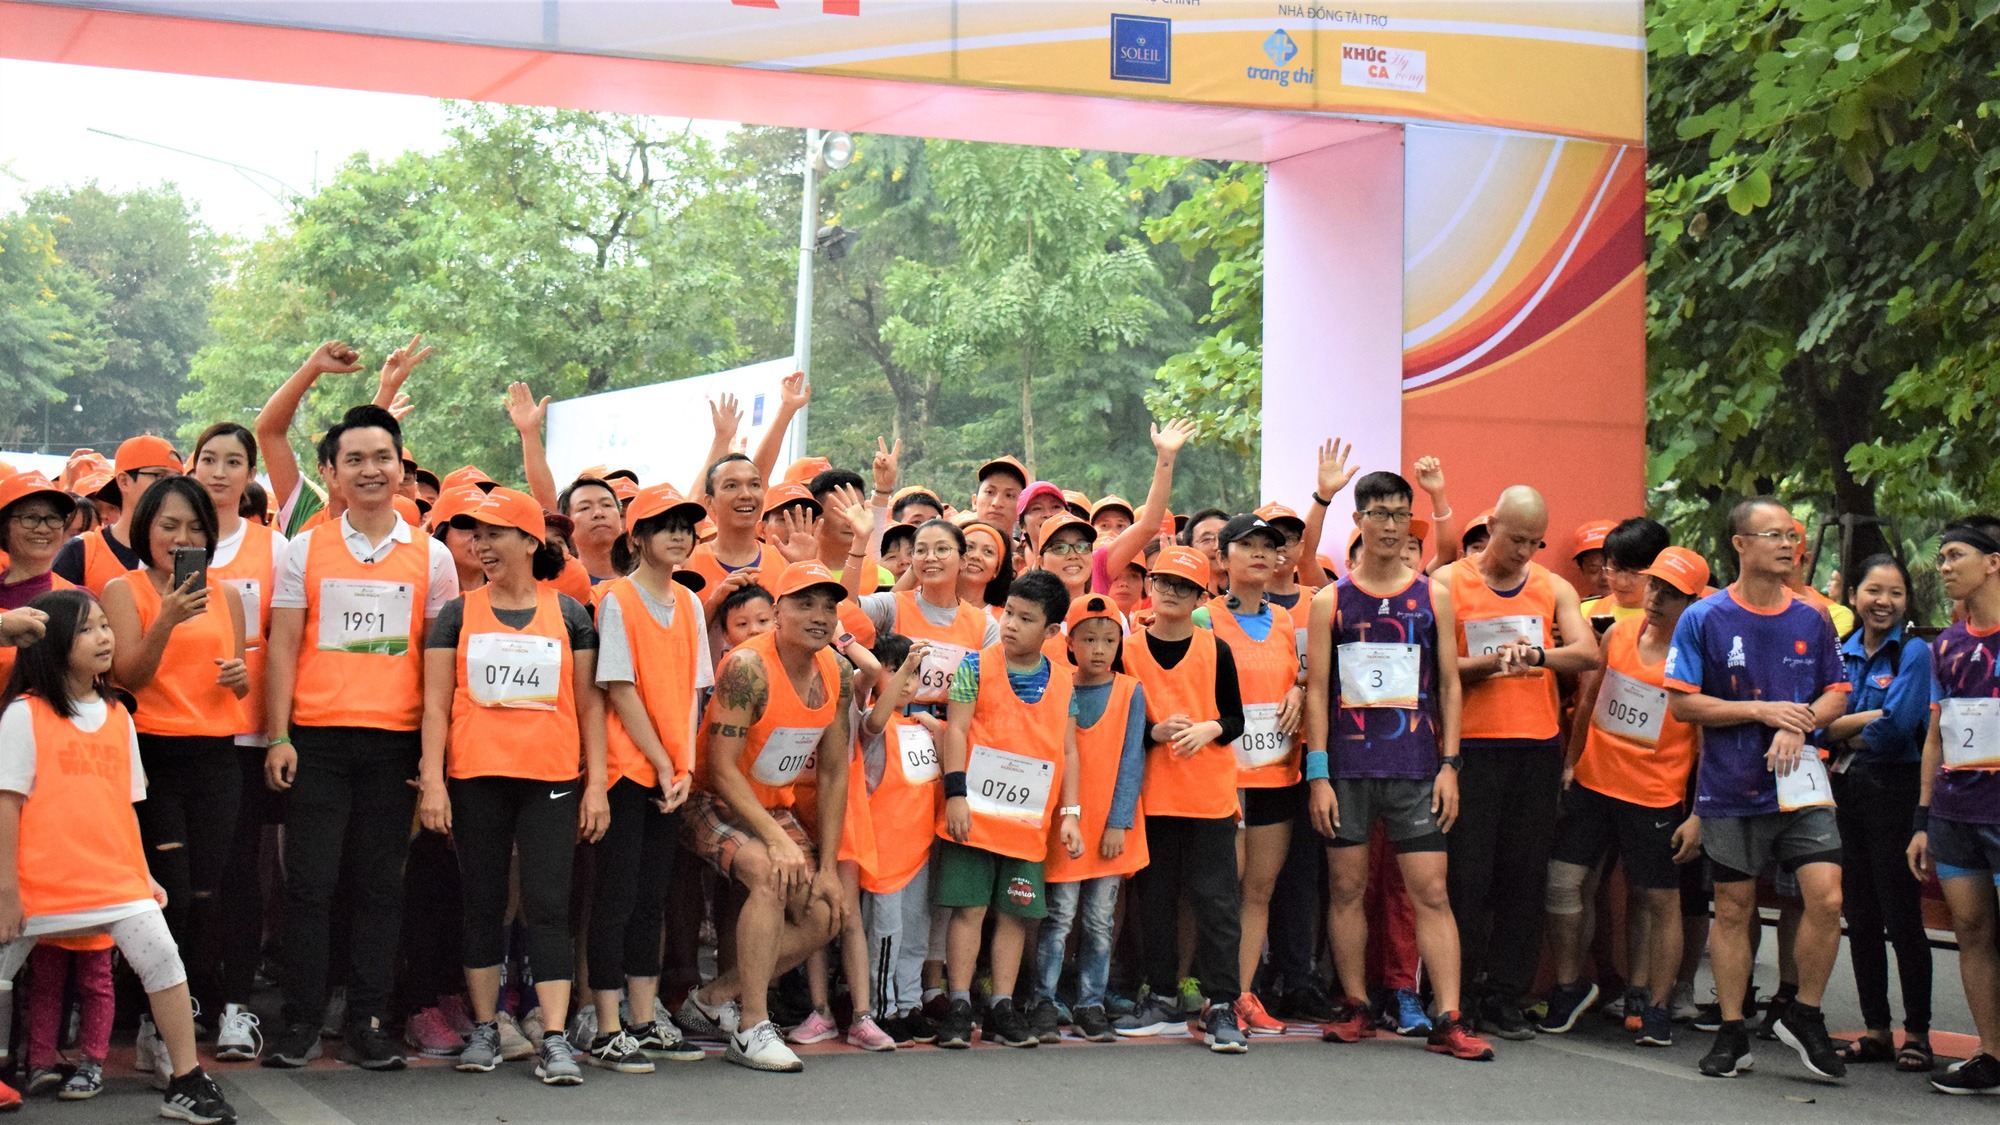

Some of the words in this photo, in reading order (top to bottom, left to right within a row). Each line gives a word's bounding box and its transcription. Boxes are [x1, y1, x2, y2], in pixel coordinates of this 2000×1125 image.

[1278, 4, 1304, 18] NHÀ
[1345, 10, 1362, 24] TÀI
[1364, 13, 1388, 30] TRỢ
[1120, 46, 1161, 62] SOLEIL
[1342, 46, 1387, 64] KHÚC
[1246, 65, 1290, 87] trang
[1293, 66, 1315, 85] thi
[1367, 64, 1389, 79] CA
[343, 611, 385, 633] 1991
[485, 664, 540, 688] 0744
[1371, 669, 1383, 688] 3
[1608, 699, 1649, 728] 0059
[1242, 731, 1284, 751] 0839
[1962, 728, 1974, 748] 2
[982, 778, 1030, 805] 0769
[1806, 772, 1816, 791] 1
